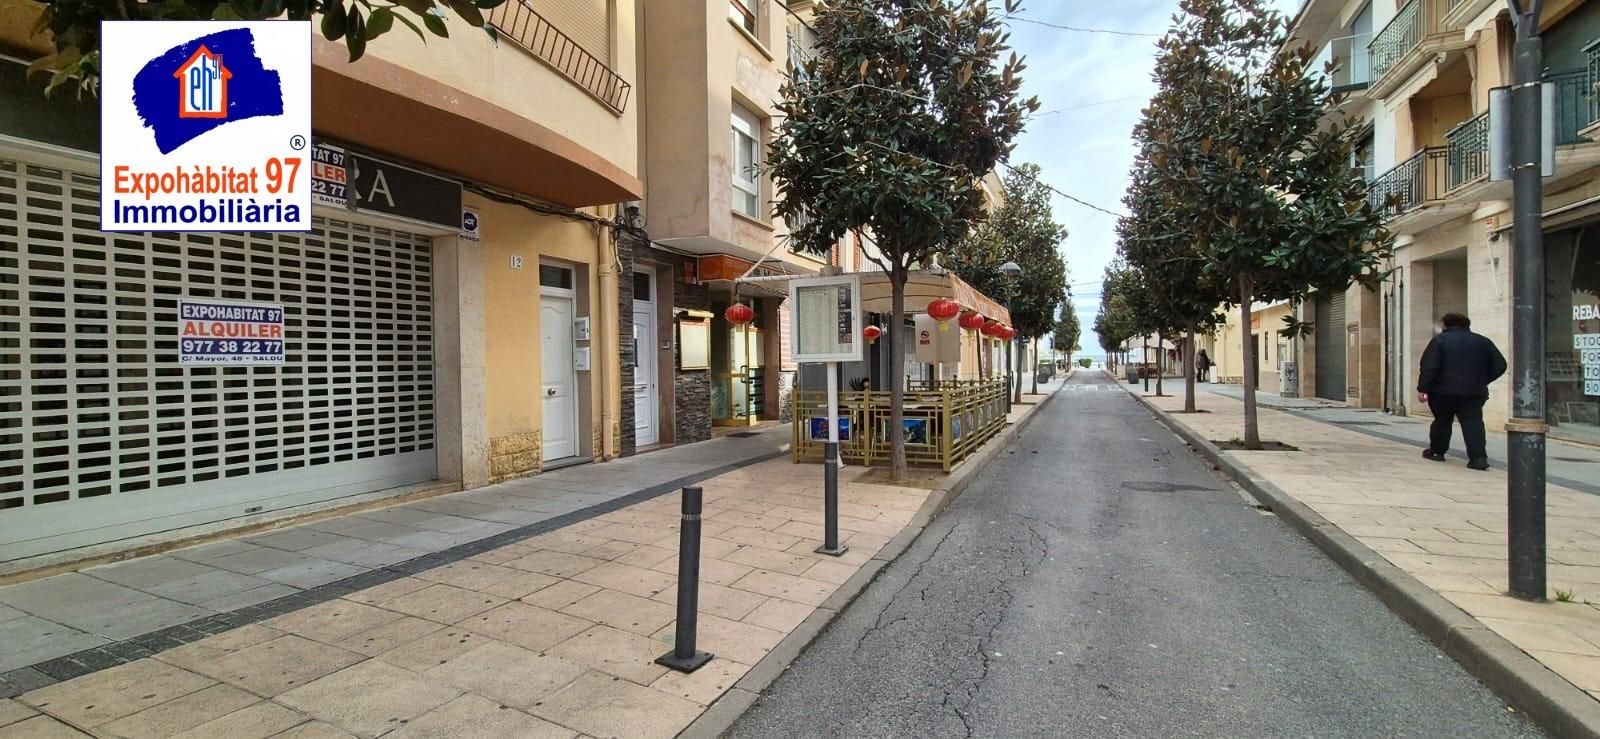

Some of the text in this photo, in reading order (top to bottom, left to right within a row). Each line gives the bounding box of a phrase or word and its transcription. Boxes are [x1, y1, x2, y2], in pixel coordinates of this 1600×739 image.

[332, 153, 345, 166] 97
[330, 184, 345, 197] 77
[512, 255, 522, 268] 12
[182, 305, 281, 322] EXPOHABITAT 97
[1573, 304, 1600, 321] REBA
[183, 321, 282, 338] ALQUILER
[183, 340, 281, 353] 977 38 22 77
